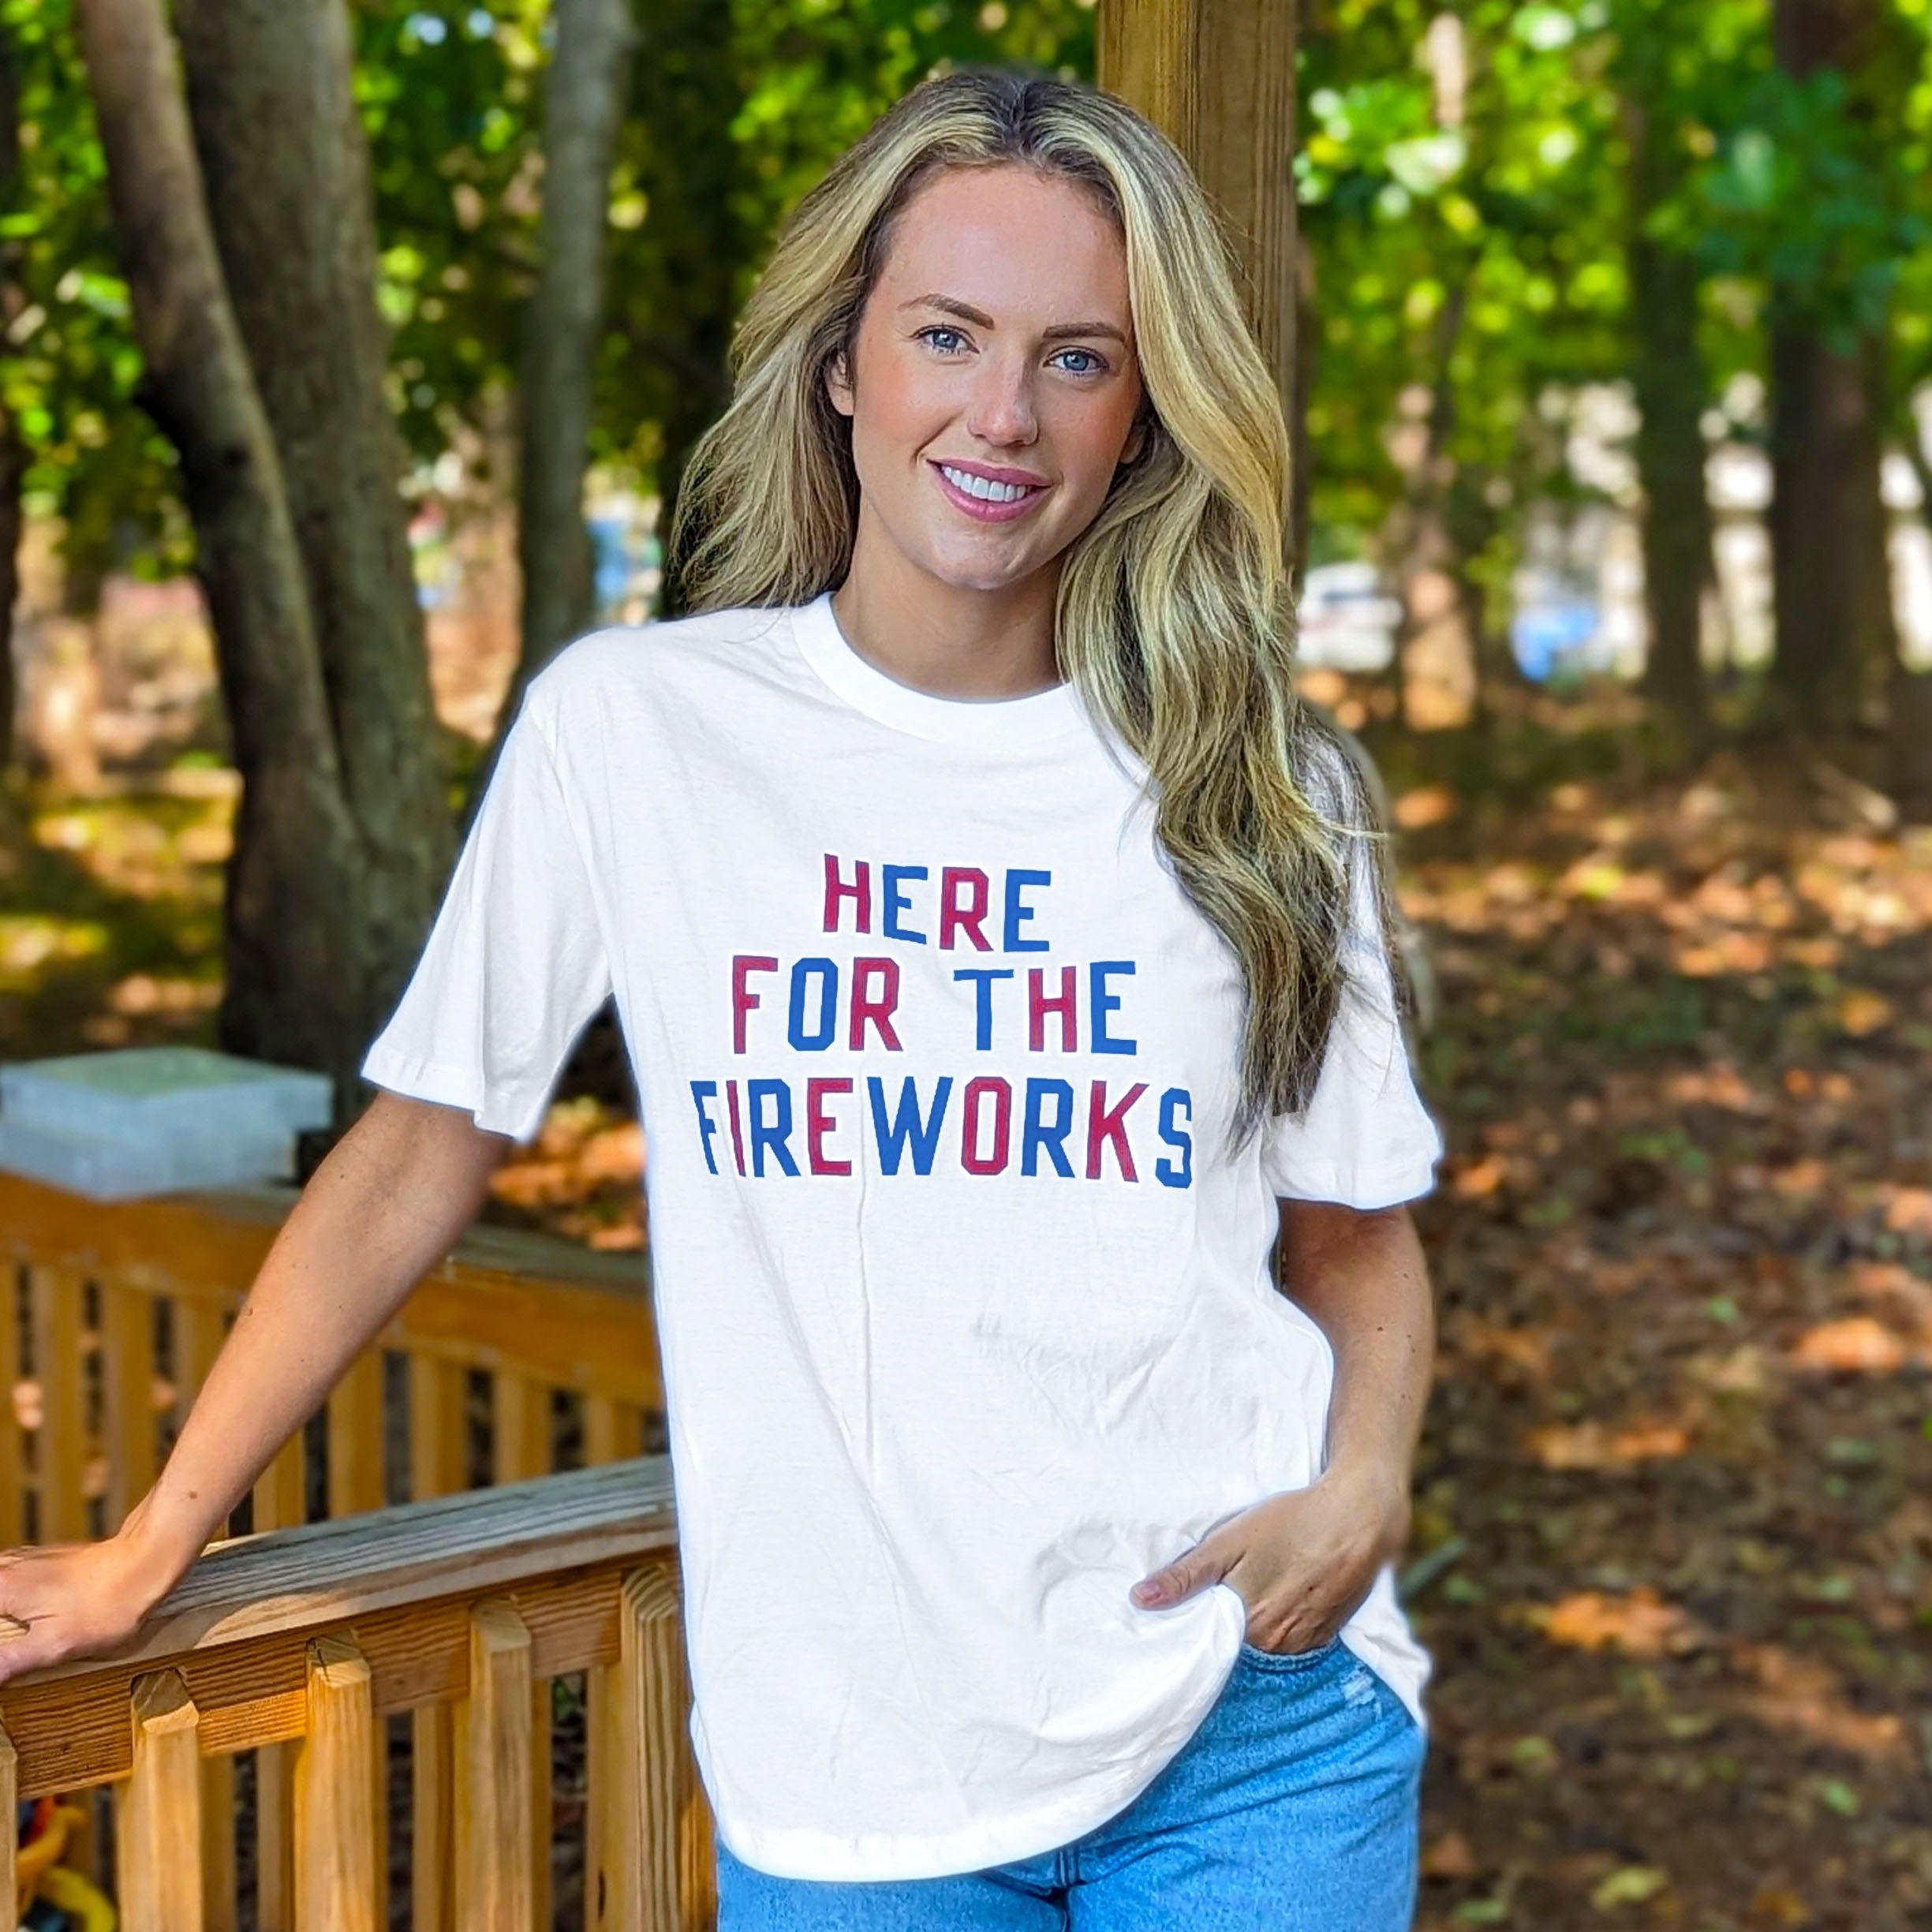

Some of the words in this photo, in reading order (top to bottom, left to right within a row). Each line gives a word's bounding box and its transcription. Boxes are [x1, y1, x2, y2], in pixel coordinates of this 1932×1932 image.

[823, 854, 1052, 952] HERE
[732, 955, 902, 1053] FOR
[953, 960, 1137, 1056] THE
[690, 1076, 1193, 1189] FIREWORKS
